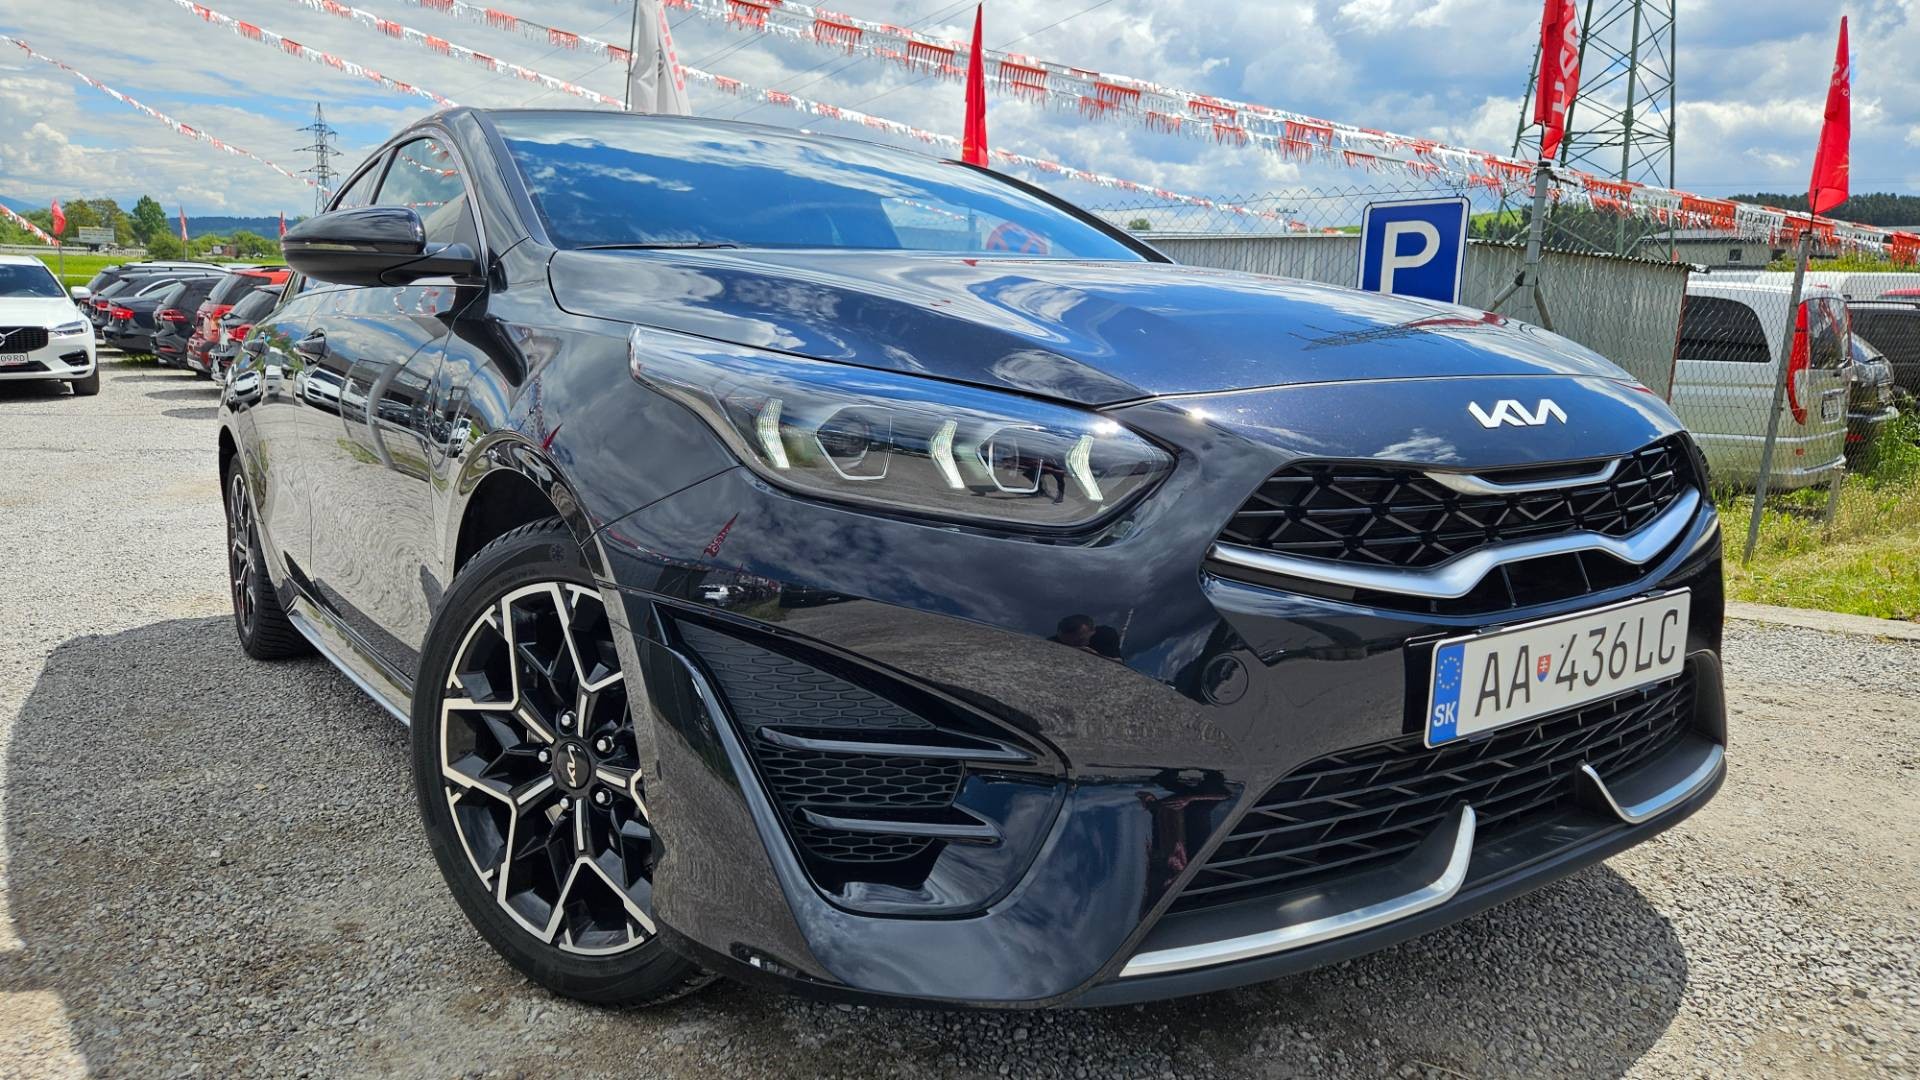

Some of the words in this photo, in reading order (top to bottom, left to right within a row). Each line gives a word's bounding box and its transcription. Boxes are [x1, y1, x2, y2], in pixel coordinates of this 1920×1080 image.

[1379, 220, 1441, 295] P
[1467, 398, 1568, 429] KIA
[1474, 645, 1531, 717] AA
[1555, 608, 1679, 692] 436LC
[1433, 701, 1456, 727] SK
